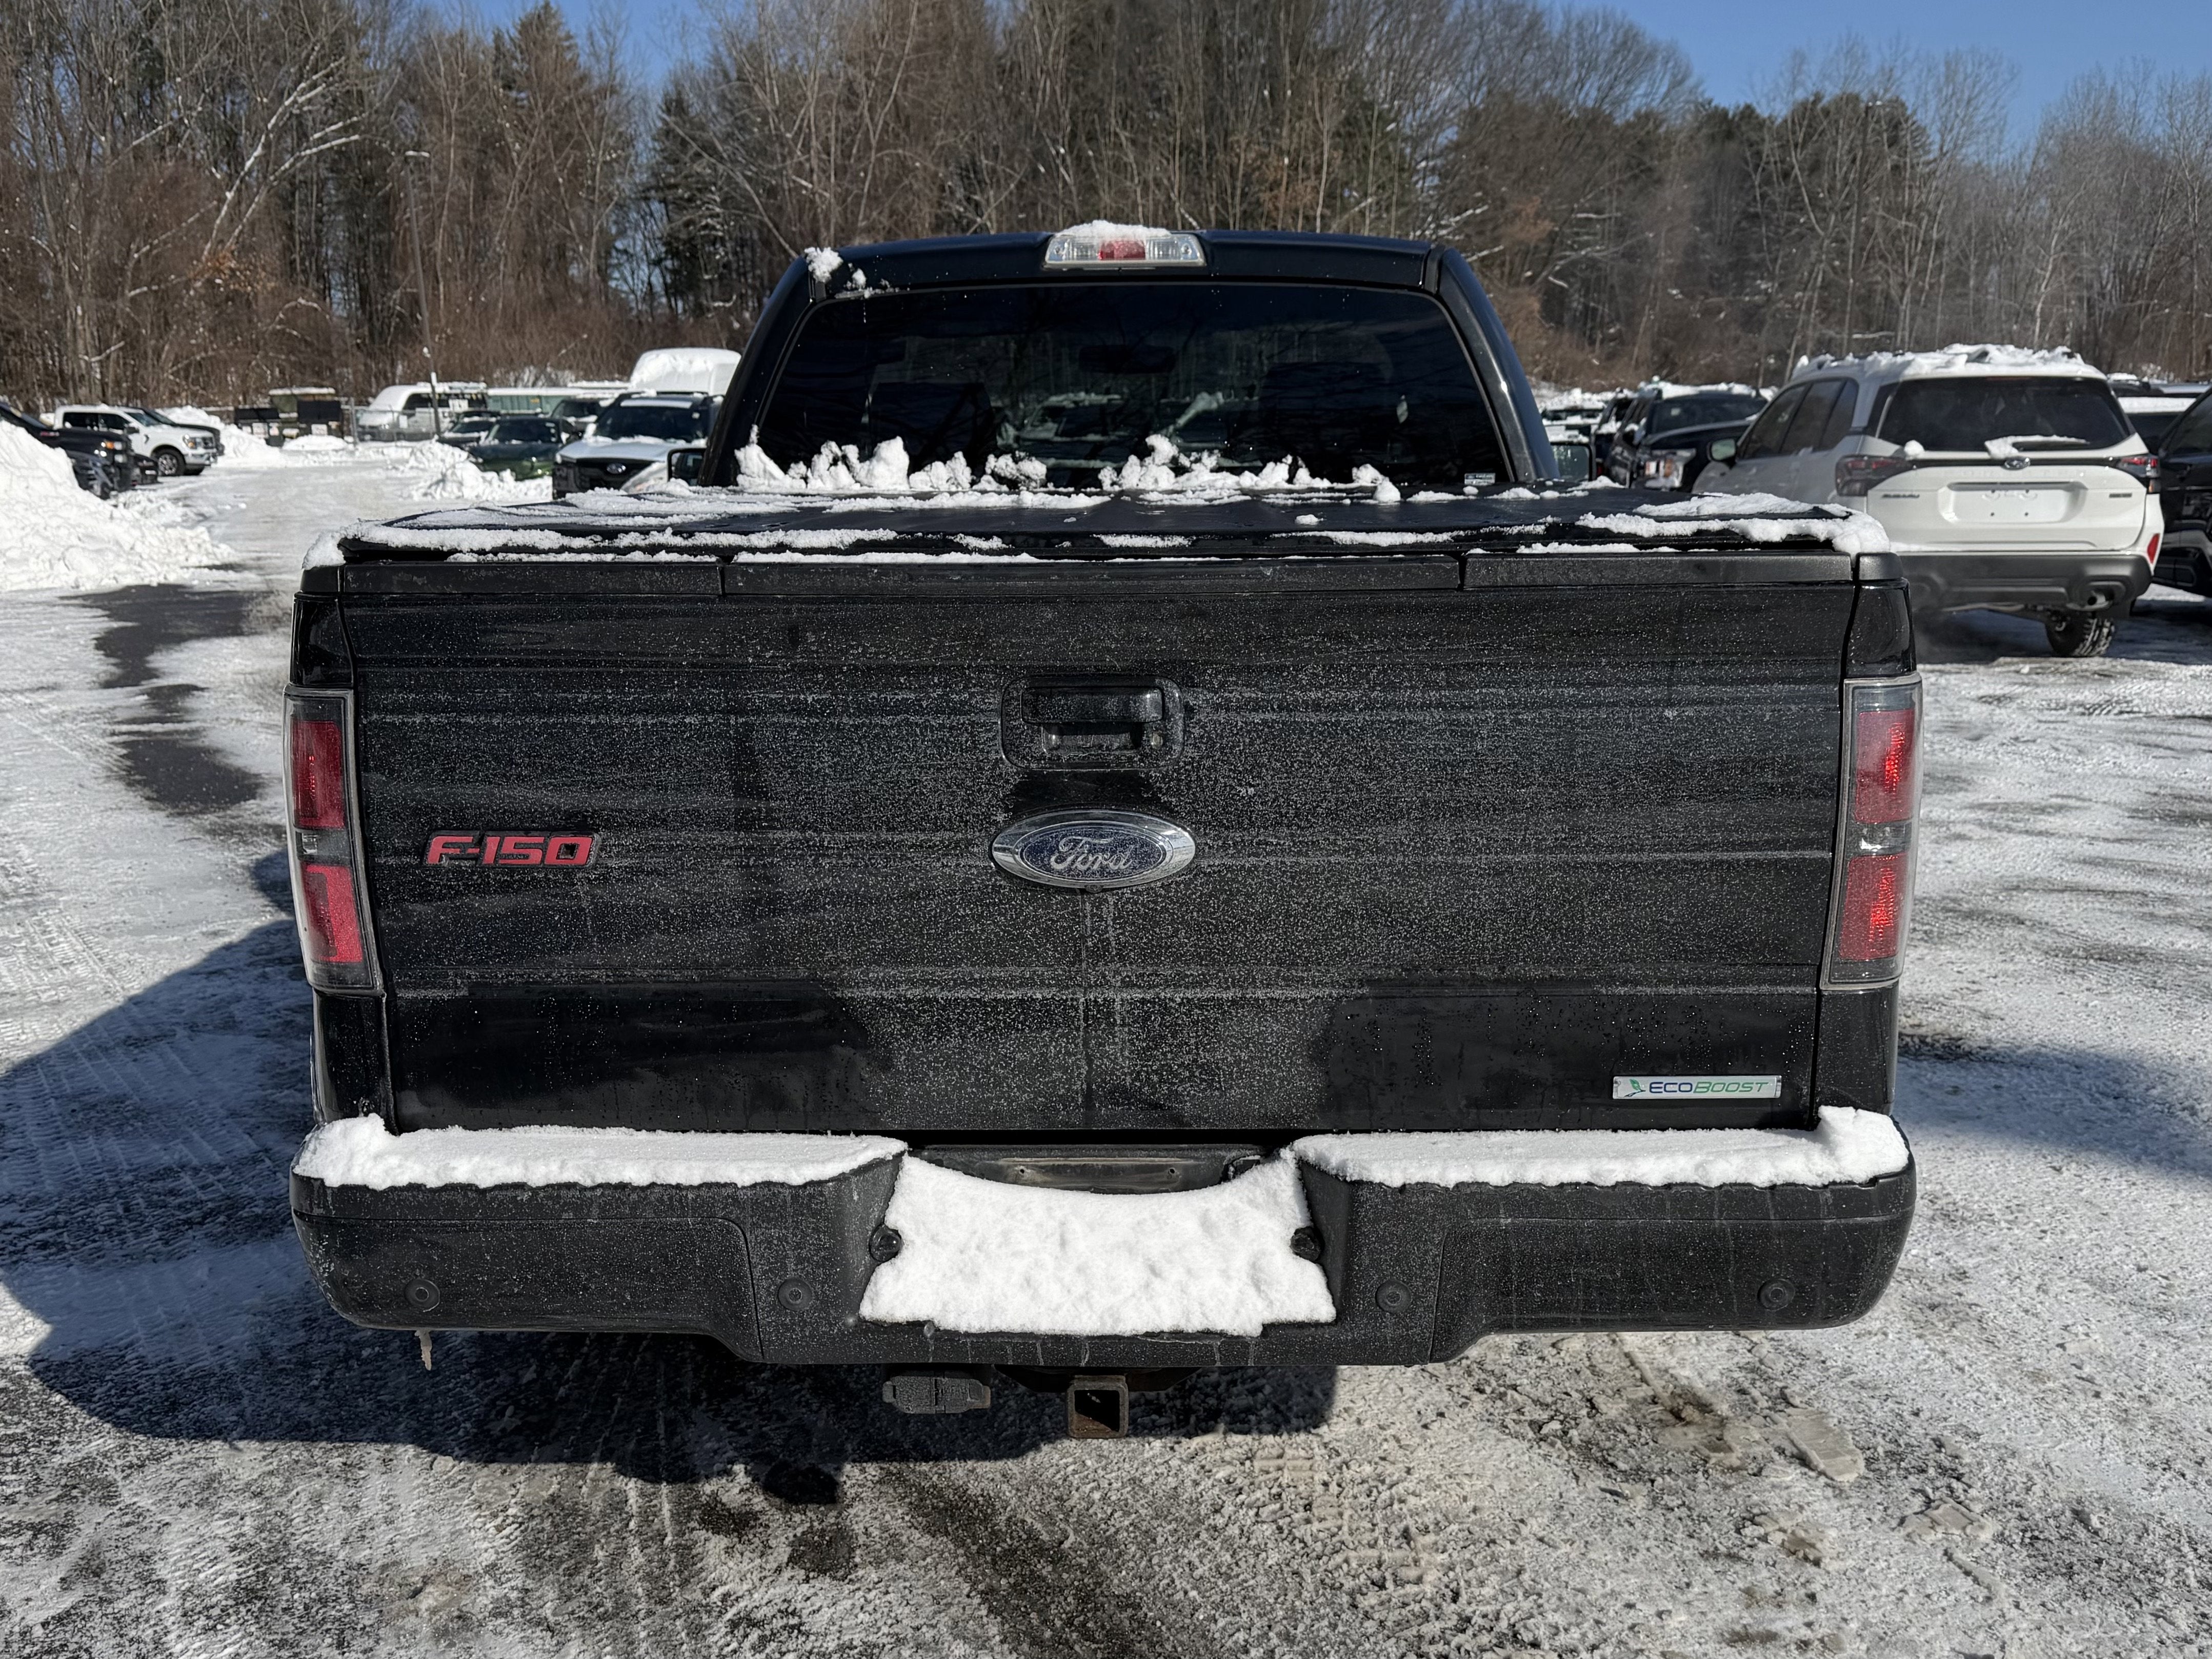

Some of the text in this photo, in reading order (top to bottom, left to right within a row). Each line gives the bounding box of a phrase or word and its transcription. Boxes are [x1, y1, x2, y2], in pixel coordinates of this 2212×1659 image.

[427, 836, 593, 864] F-150
[1050, 836, 1136, 870] Ford
[1650, 1081, 1768, 1094] ECOBOOST
